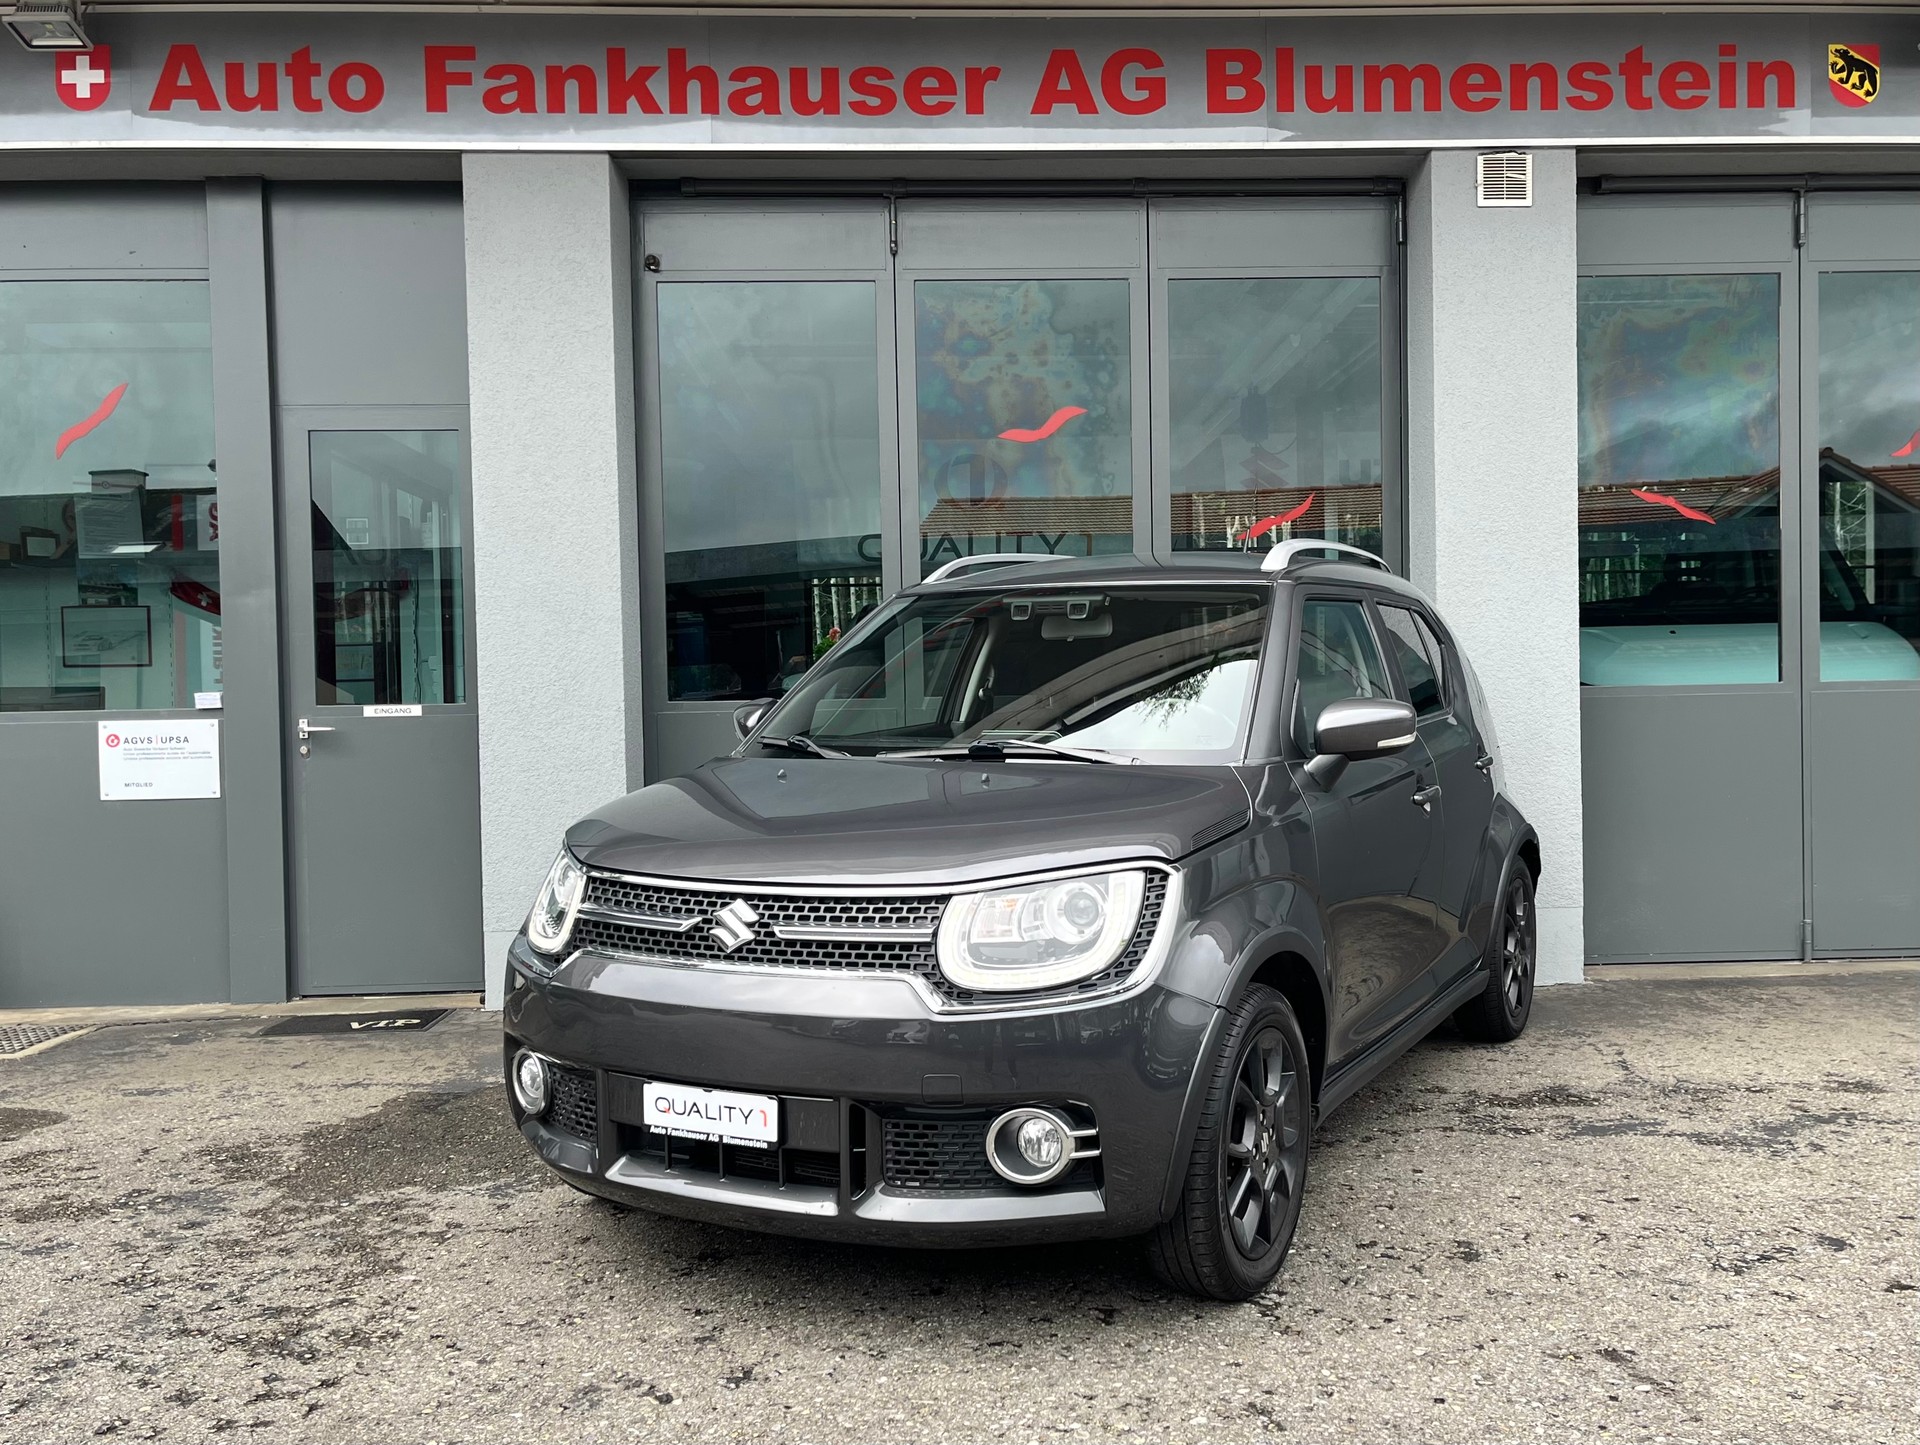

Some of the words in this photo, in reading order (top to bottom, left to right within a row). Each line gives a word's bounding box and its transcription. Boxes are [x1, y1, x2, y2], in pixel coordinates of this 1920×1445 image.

[148, 44, 385, 114] Auto
[423, 45, 1001, 116] Fankhauser
[1030, 47, 1167, 116] AG
[1204, 43, 1796, 115] Blumenstein
[857, 532, 1069, 562] QALITY
[123, 736, 153, 745] AGVS
[160, 735, 189, 744] UPSA
[350, 1018, 421, 1030] VIP
[654, 1096, 754, 1125] QUALITY
[649, 1124, 667, 1135] Auto
[667, 1127, 707, 1141] Fankhauser
[707, 1133, 720, 1143] AG
[722, 1135, 768, 1149] Blumenstein
